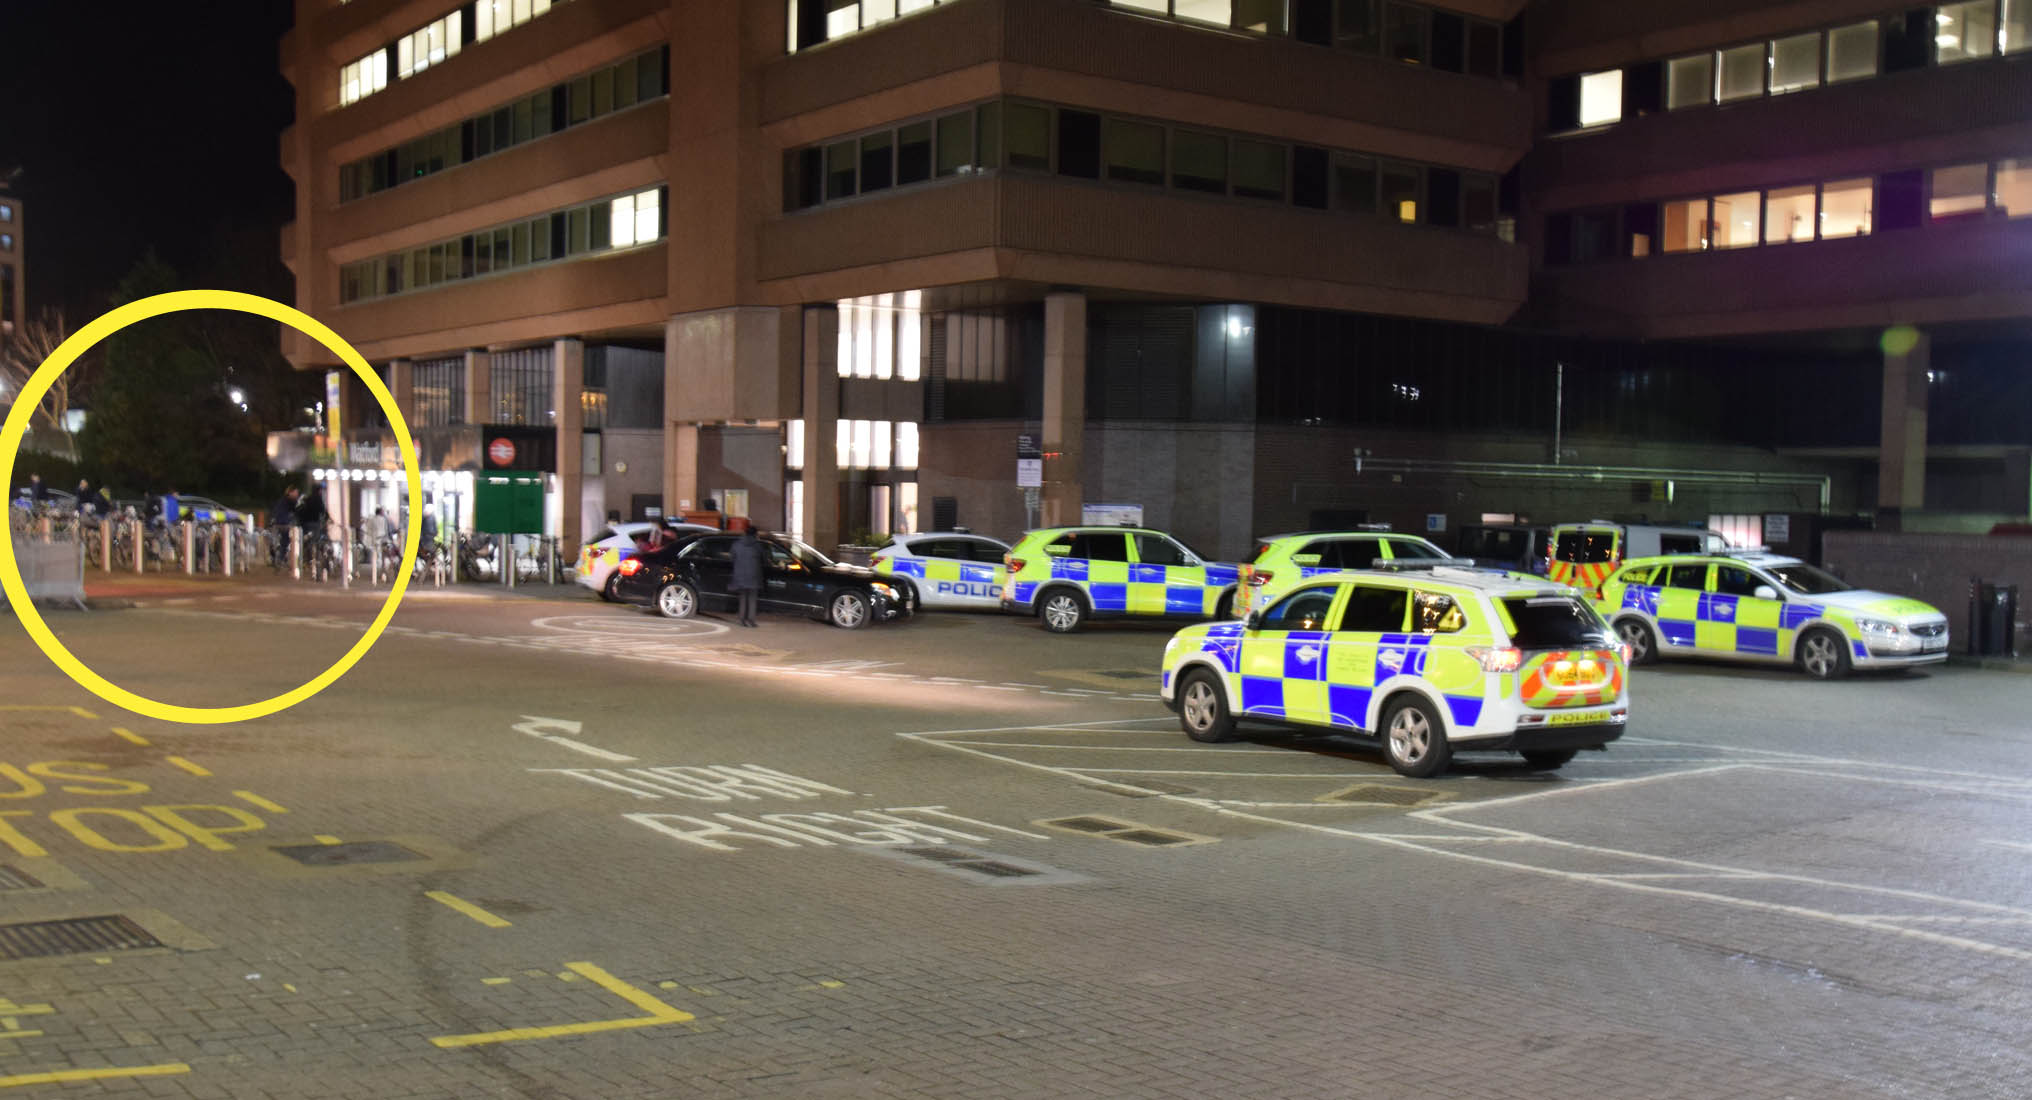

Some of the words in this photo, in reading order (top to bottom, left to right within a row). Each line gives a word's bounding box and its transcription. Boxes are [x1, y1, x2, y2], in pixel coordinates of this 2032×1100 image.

[937, 582, 1003, 597] POLIC
[1551, 711, 1606, 722] POLICE
[526, 763, 857, 800] TURN
[621, 805, 1050, 851] RIGHT
